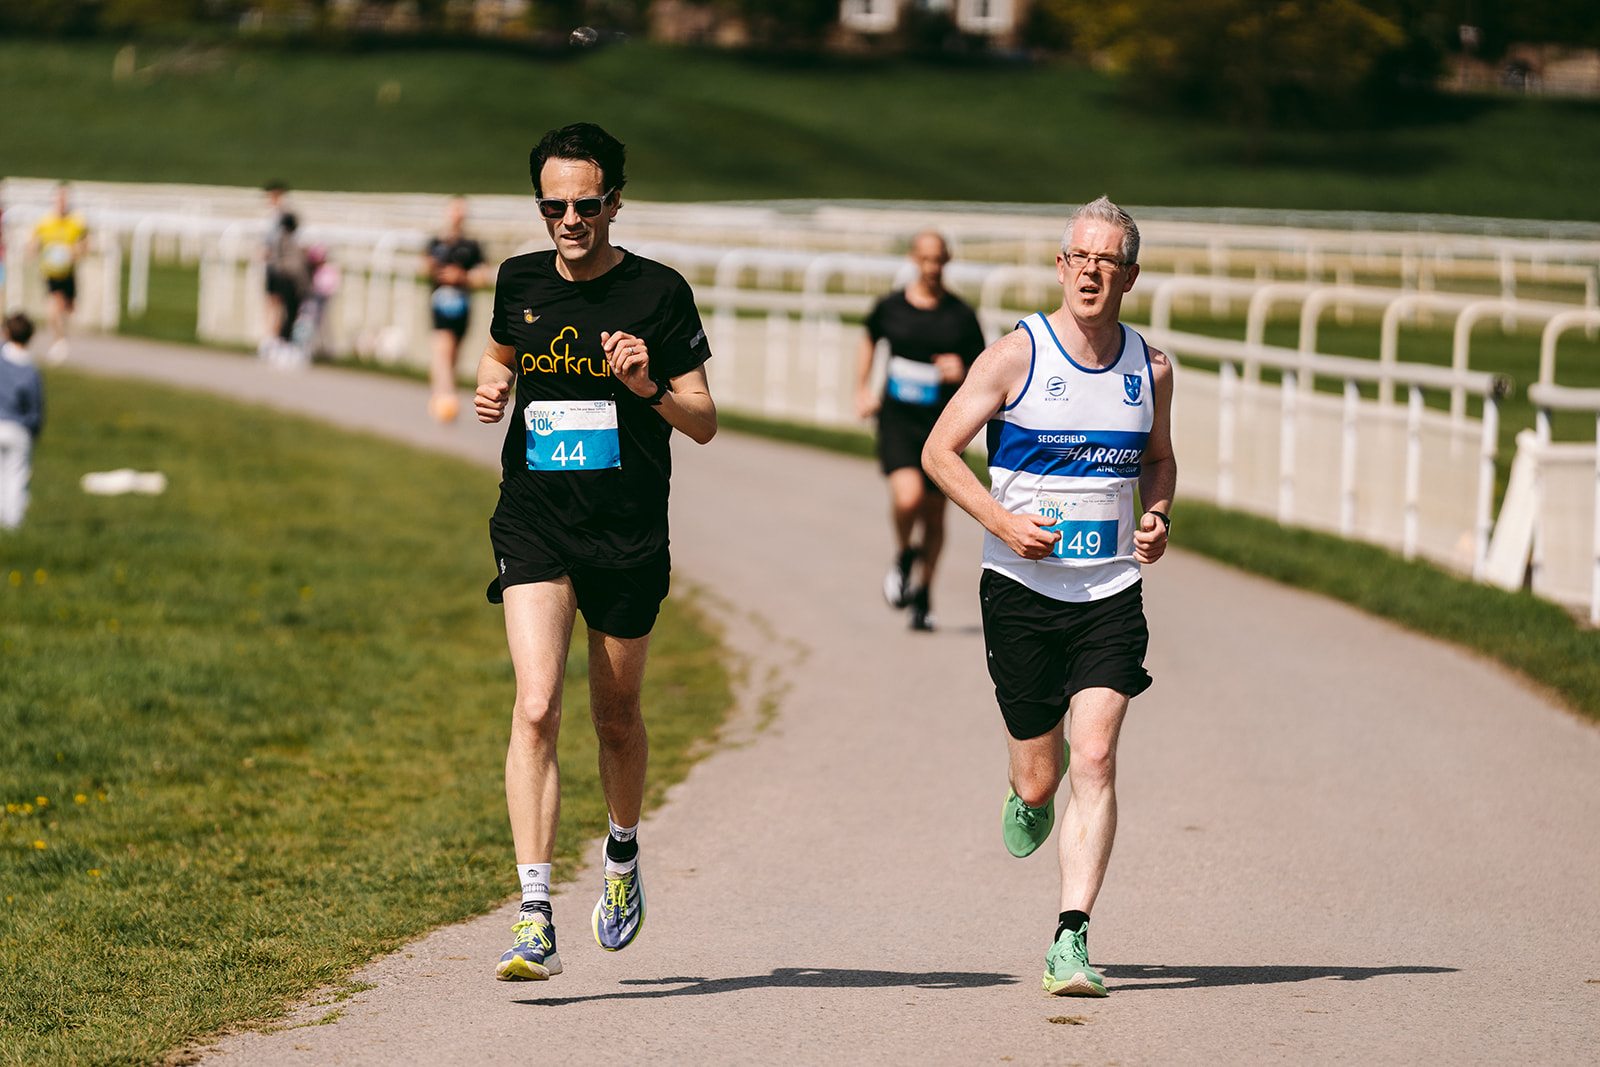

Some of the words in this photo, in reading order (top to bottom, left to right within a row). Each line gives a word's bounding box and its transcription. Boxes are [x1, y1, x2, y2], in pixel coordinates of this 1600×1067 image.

[529, 410, 550, 418] TEWV
[530, 418, 554, 431] 10k
[1037, 434, 1087, 443] SEDGEFIELD
[551, 440, 587, 467] 44
[1038, 500, 1061, 508] TEWV
[1038, 507, 1064, 521] 10k
[1058, 530, 1102, 556] 149
